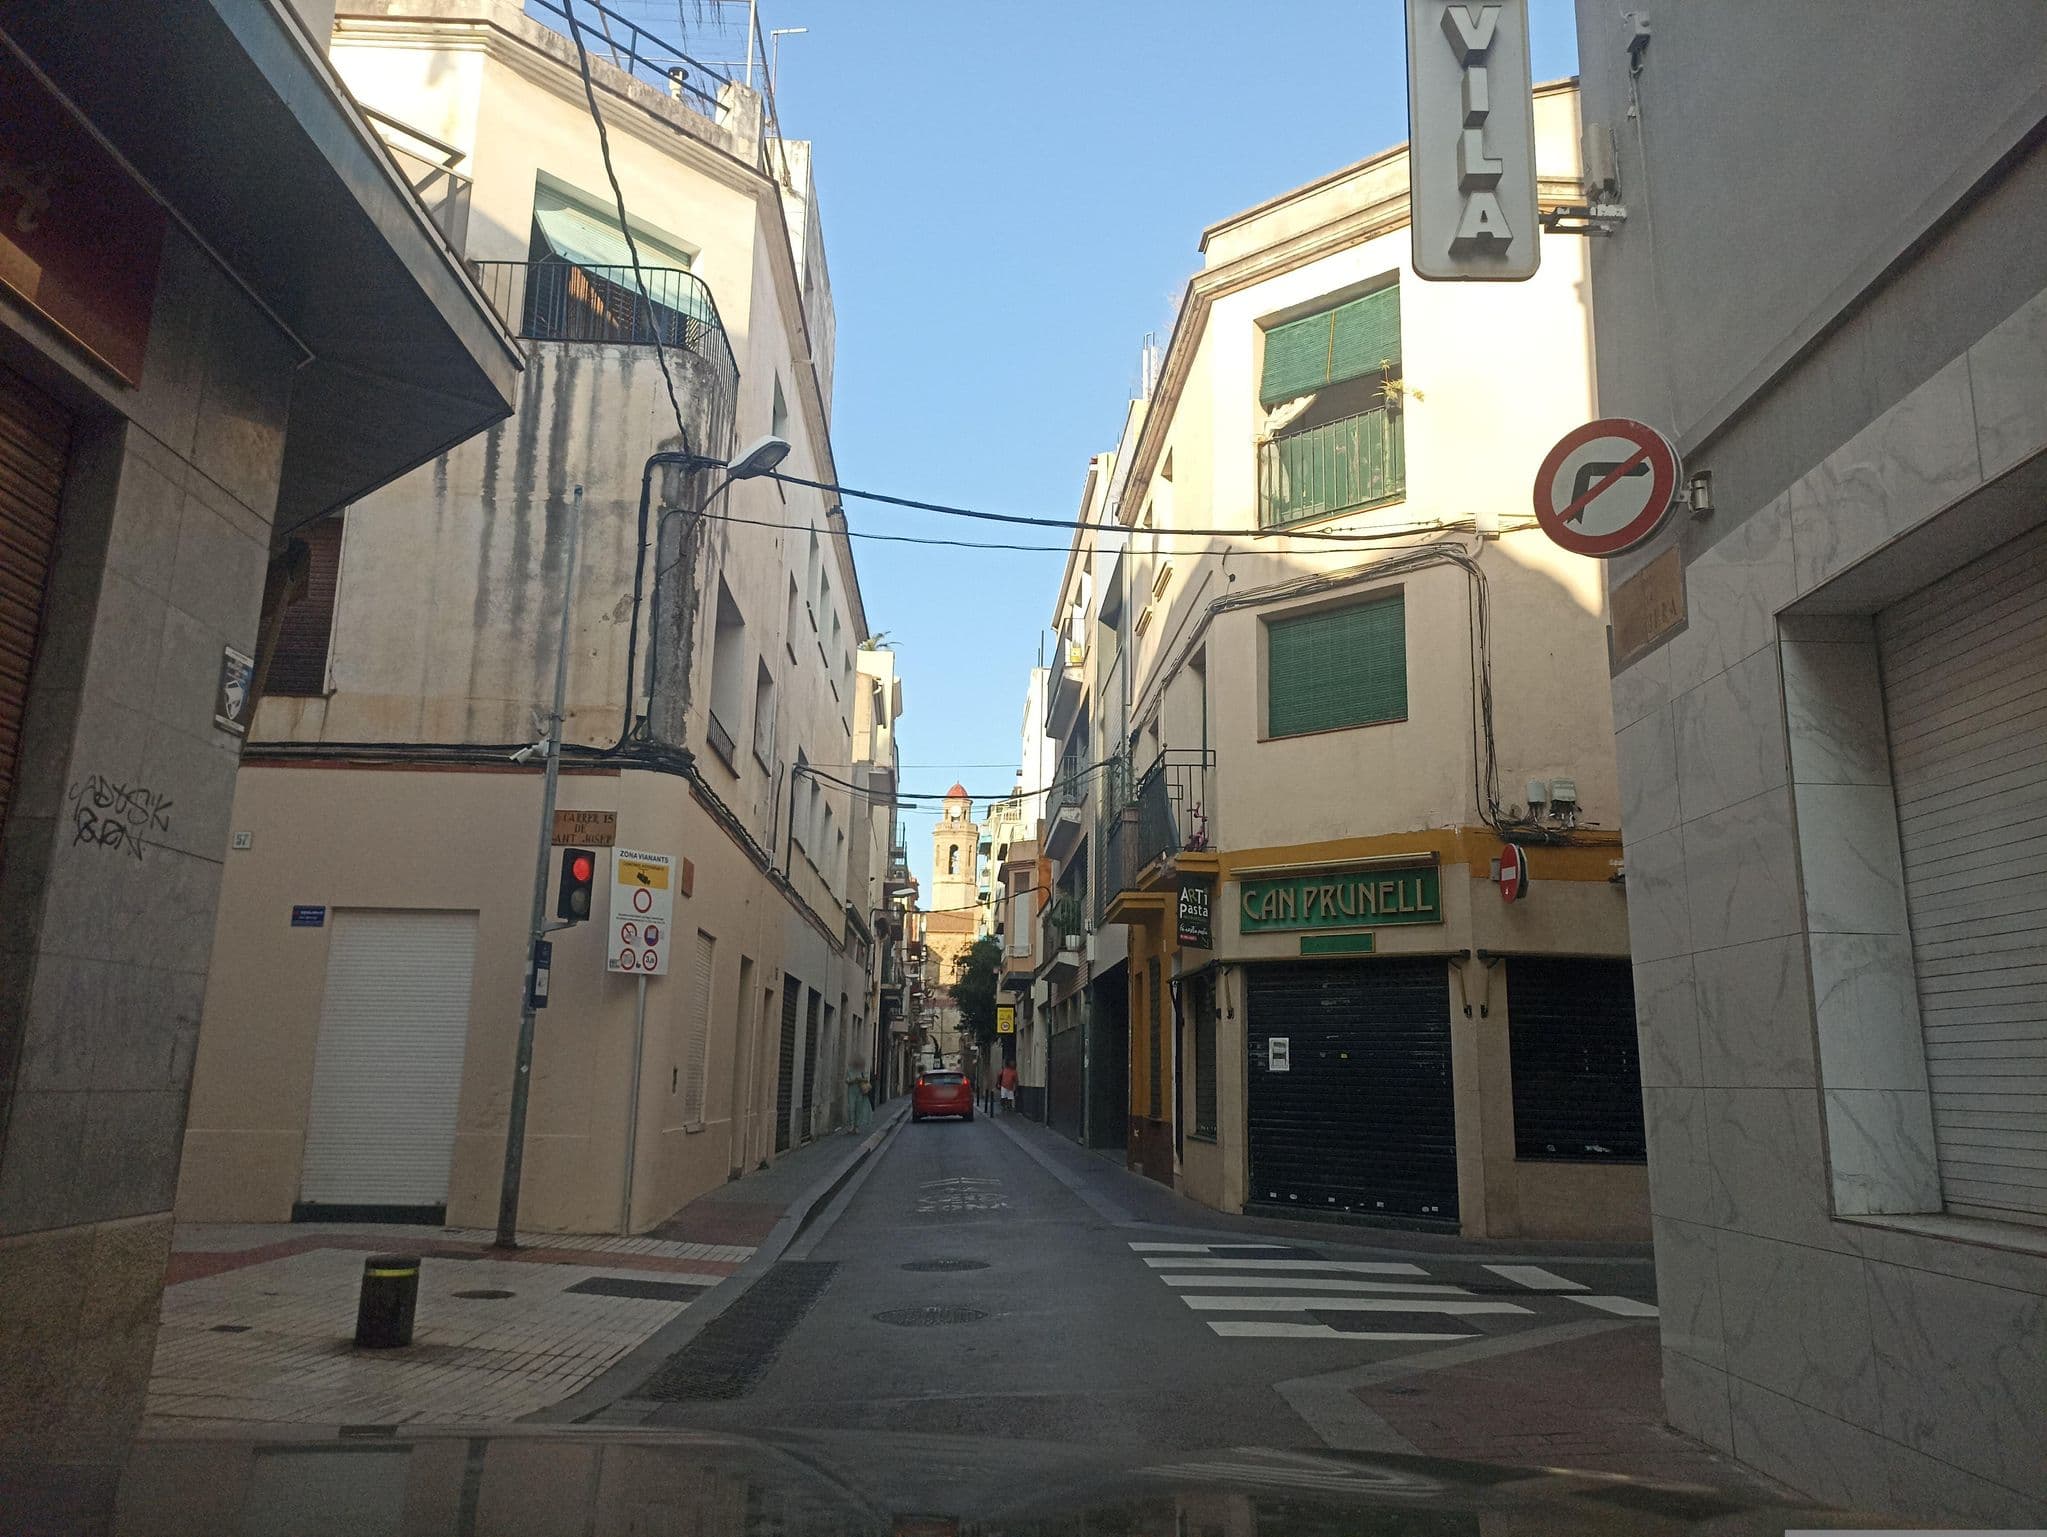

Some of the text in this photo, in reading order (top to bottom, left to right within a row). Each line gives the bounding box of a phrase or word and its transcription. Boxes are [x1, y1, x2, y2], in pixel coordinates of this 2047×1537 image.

[1442, 5, 1513, 254] VILA
[551, 833, 577, 843] ANT
[619, 850, 669, 864] ZONA VIANANTS
[1243, 878, 1434, 921] CAN PRUNELL
